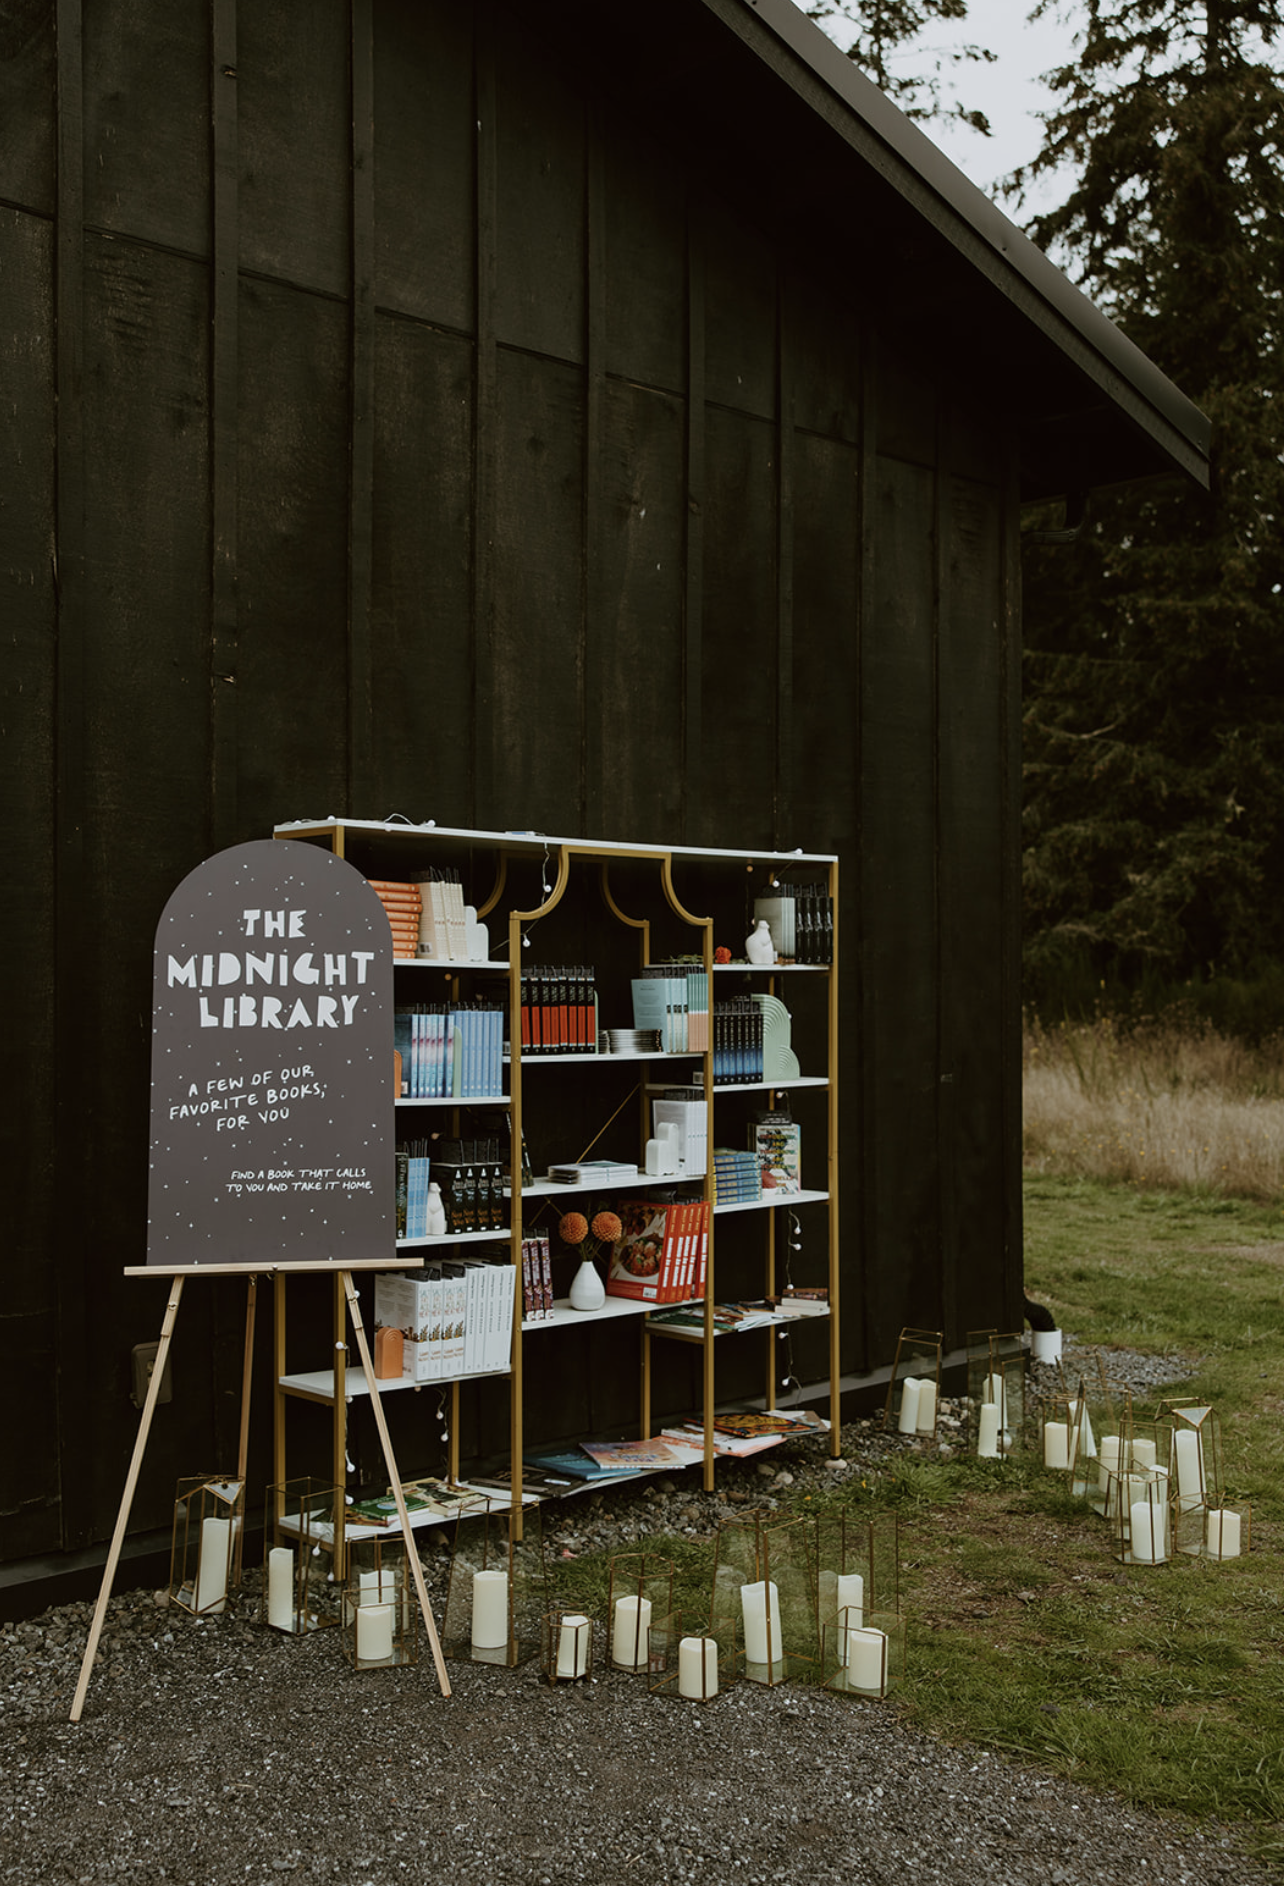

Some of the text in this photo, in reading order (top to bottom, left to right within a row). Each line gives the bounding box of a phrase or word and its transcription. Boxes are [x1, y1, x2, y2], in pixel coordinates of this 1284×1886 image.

[243, 909, 307, 938] THE
[167, 951, 375, 988] MIDNIGHT
[199, 995, 360, 1029] LIBRARY
[188, 1064, 315, 1098] A FEW OF OUR
[169, 1093, 259, 1120] FAVORITE
[216, 1107, 290, 1132] FOR YOU
[226, 1180, 373, 1193] TO YOU AND TAKE IT HOME
[230, 1167, 367, 1180] FIND A BOOK THAT CALLS
